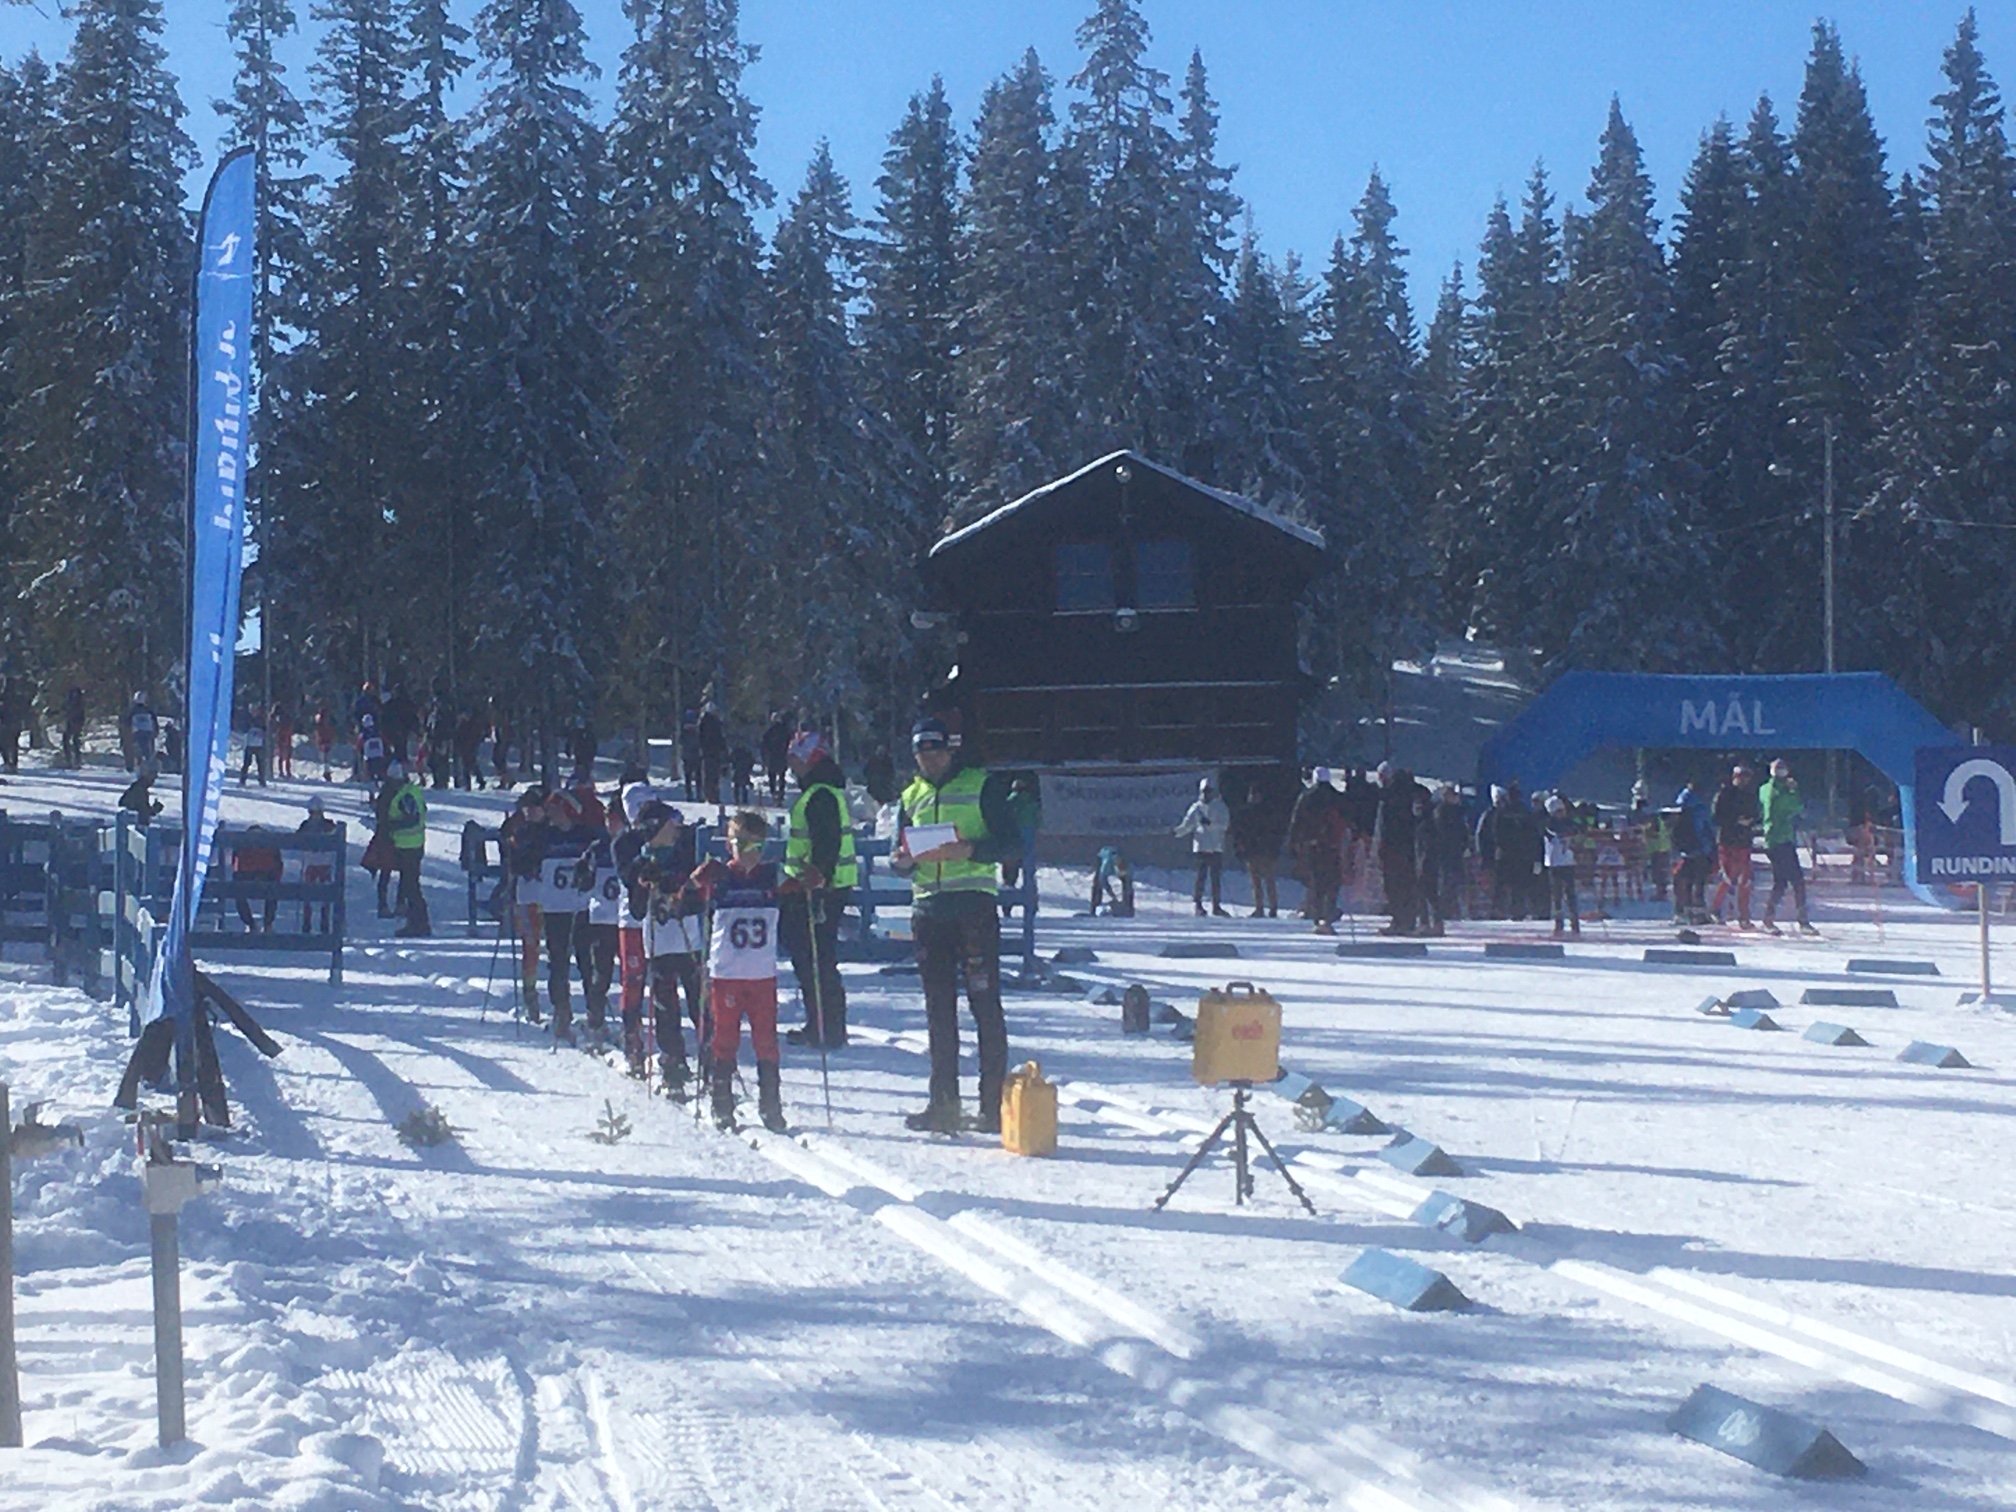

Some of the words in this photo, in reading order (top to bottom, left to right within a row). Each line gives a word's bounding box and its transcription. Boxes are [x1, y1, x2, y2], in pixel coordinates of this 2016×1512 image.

[1680, 692, 1776, 735] MÅL
[1931, 857, 2016, 875] RUNDIN
[731, 918, 767, 949] 63
